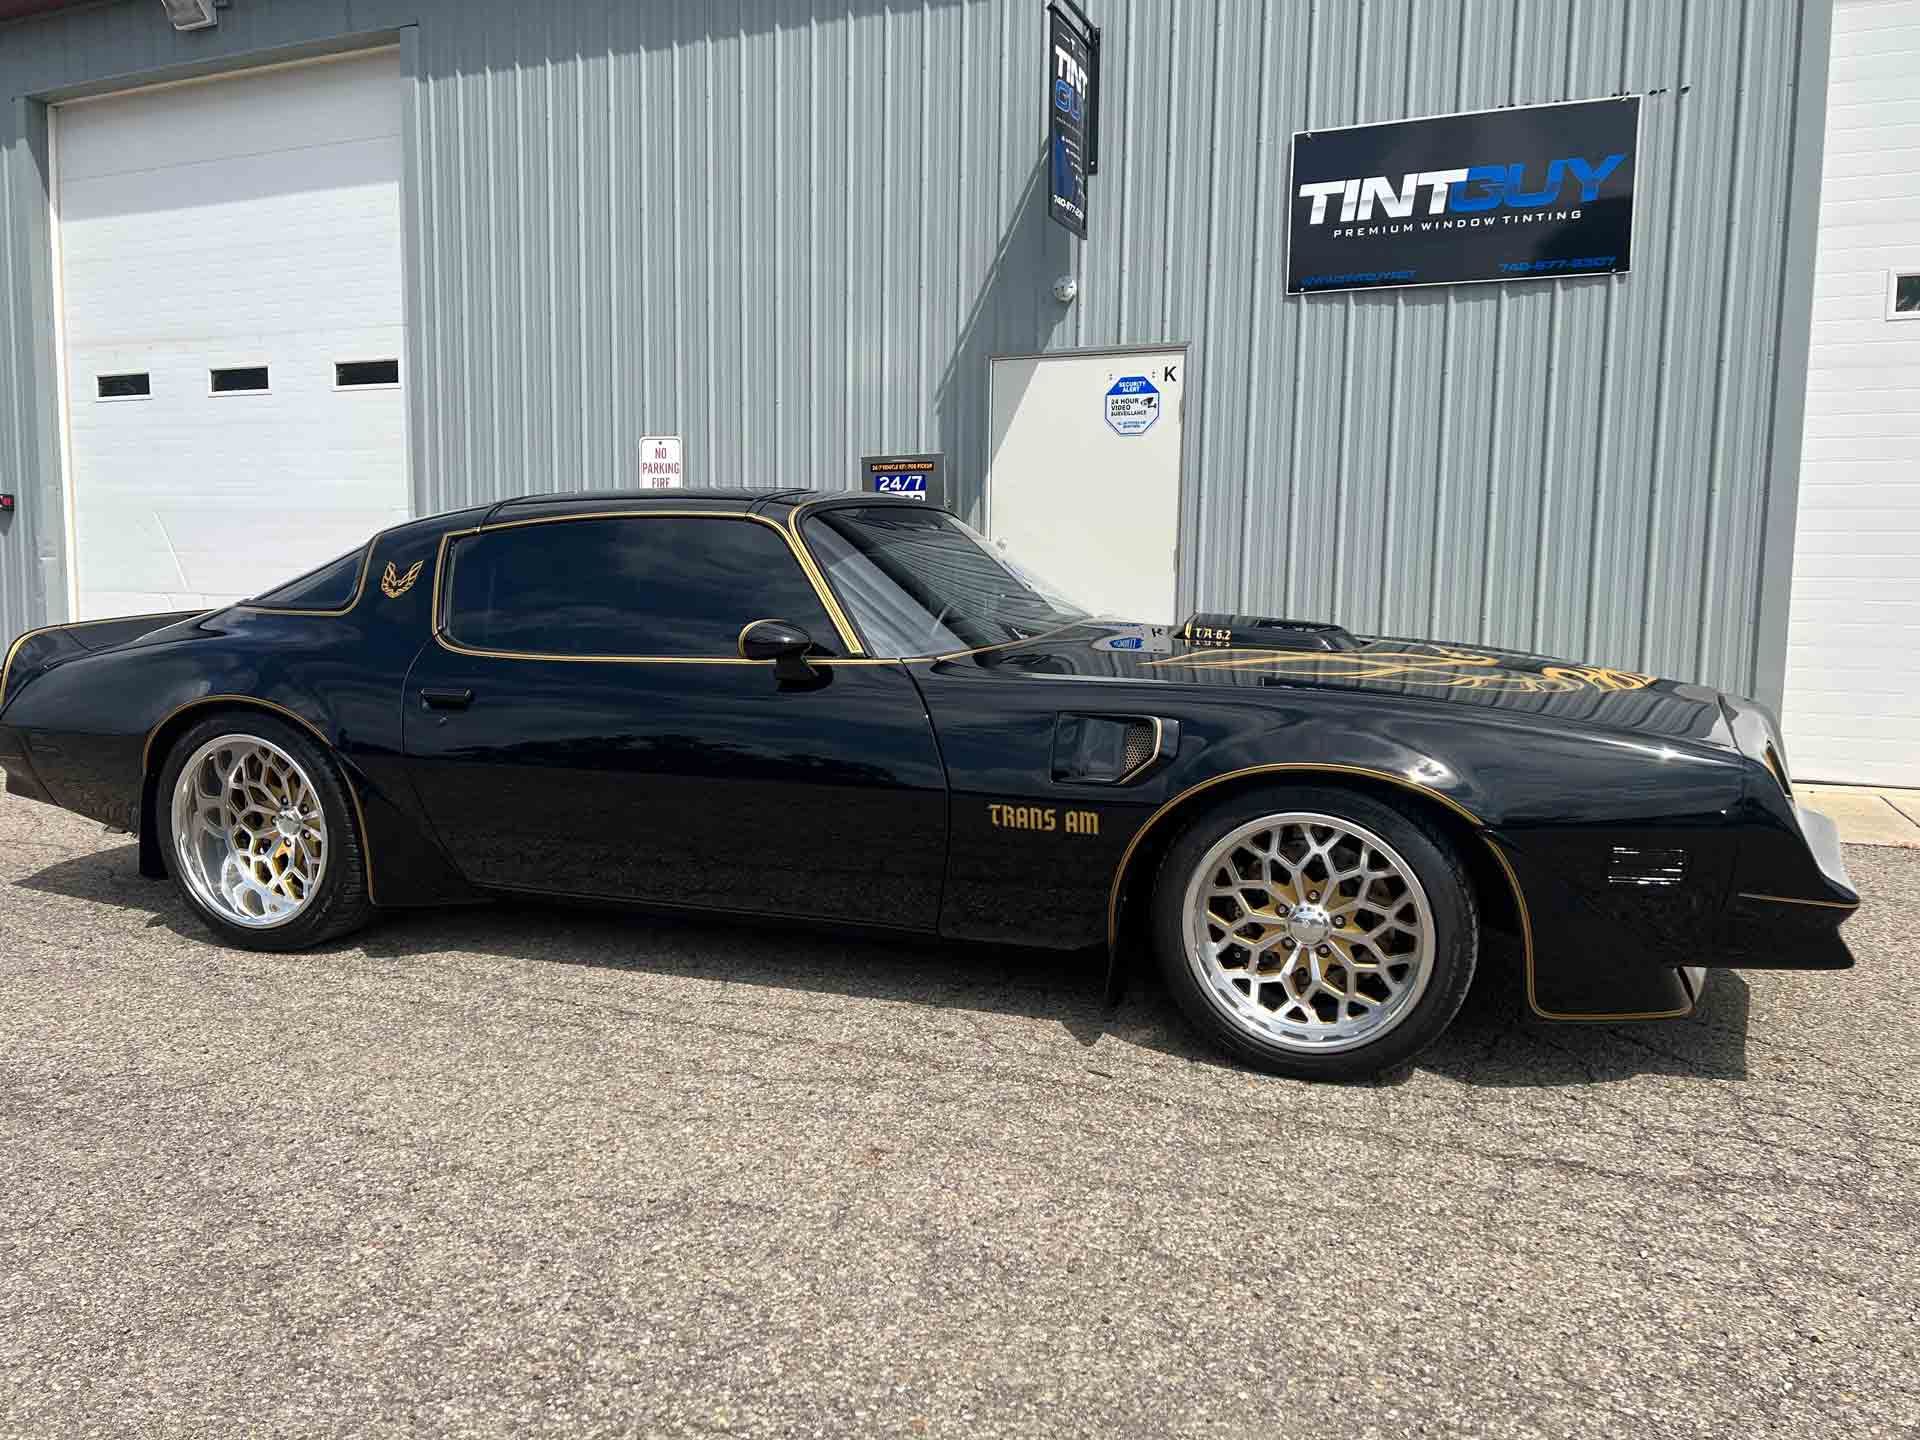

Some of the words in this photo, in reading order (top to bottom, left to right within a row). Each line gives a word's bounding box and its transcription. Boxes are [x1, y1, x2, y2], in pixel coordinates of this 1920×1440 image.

[1055, 44, 1088, 101] TINT
[1055, 79, 1084, 121] GU
[1333, 223, 1414, 239] PREMIUM
[1420, 216, 1497, 233] WINDOW
[1502, 209, 1582, 225] TINTING
[1164, 366, 1177, 382] K
[655, 447, 667, 459] NO
[642, 462, 680, 474] PARKING
[652, 477, 670, 489] FIRE
[879, 475, 923, 491] 24/7
[989, 804, 1057, 831] TRANS
[1065, 810, 1100, 834] AM
